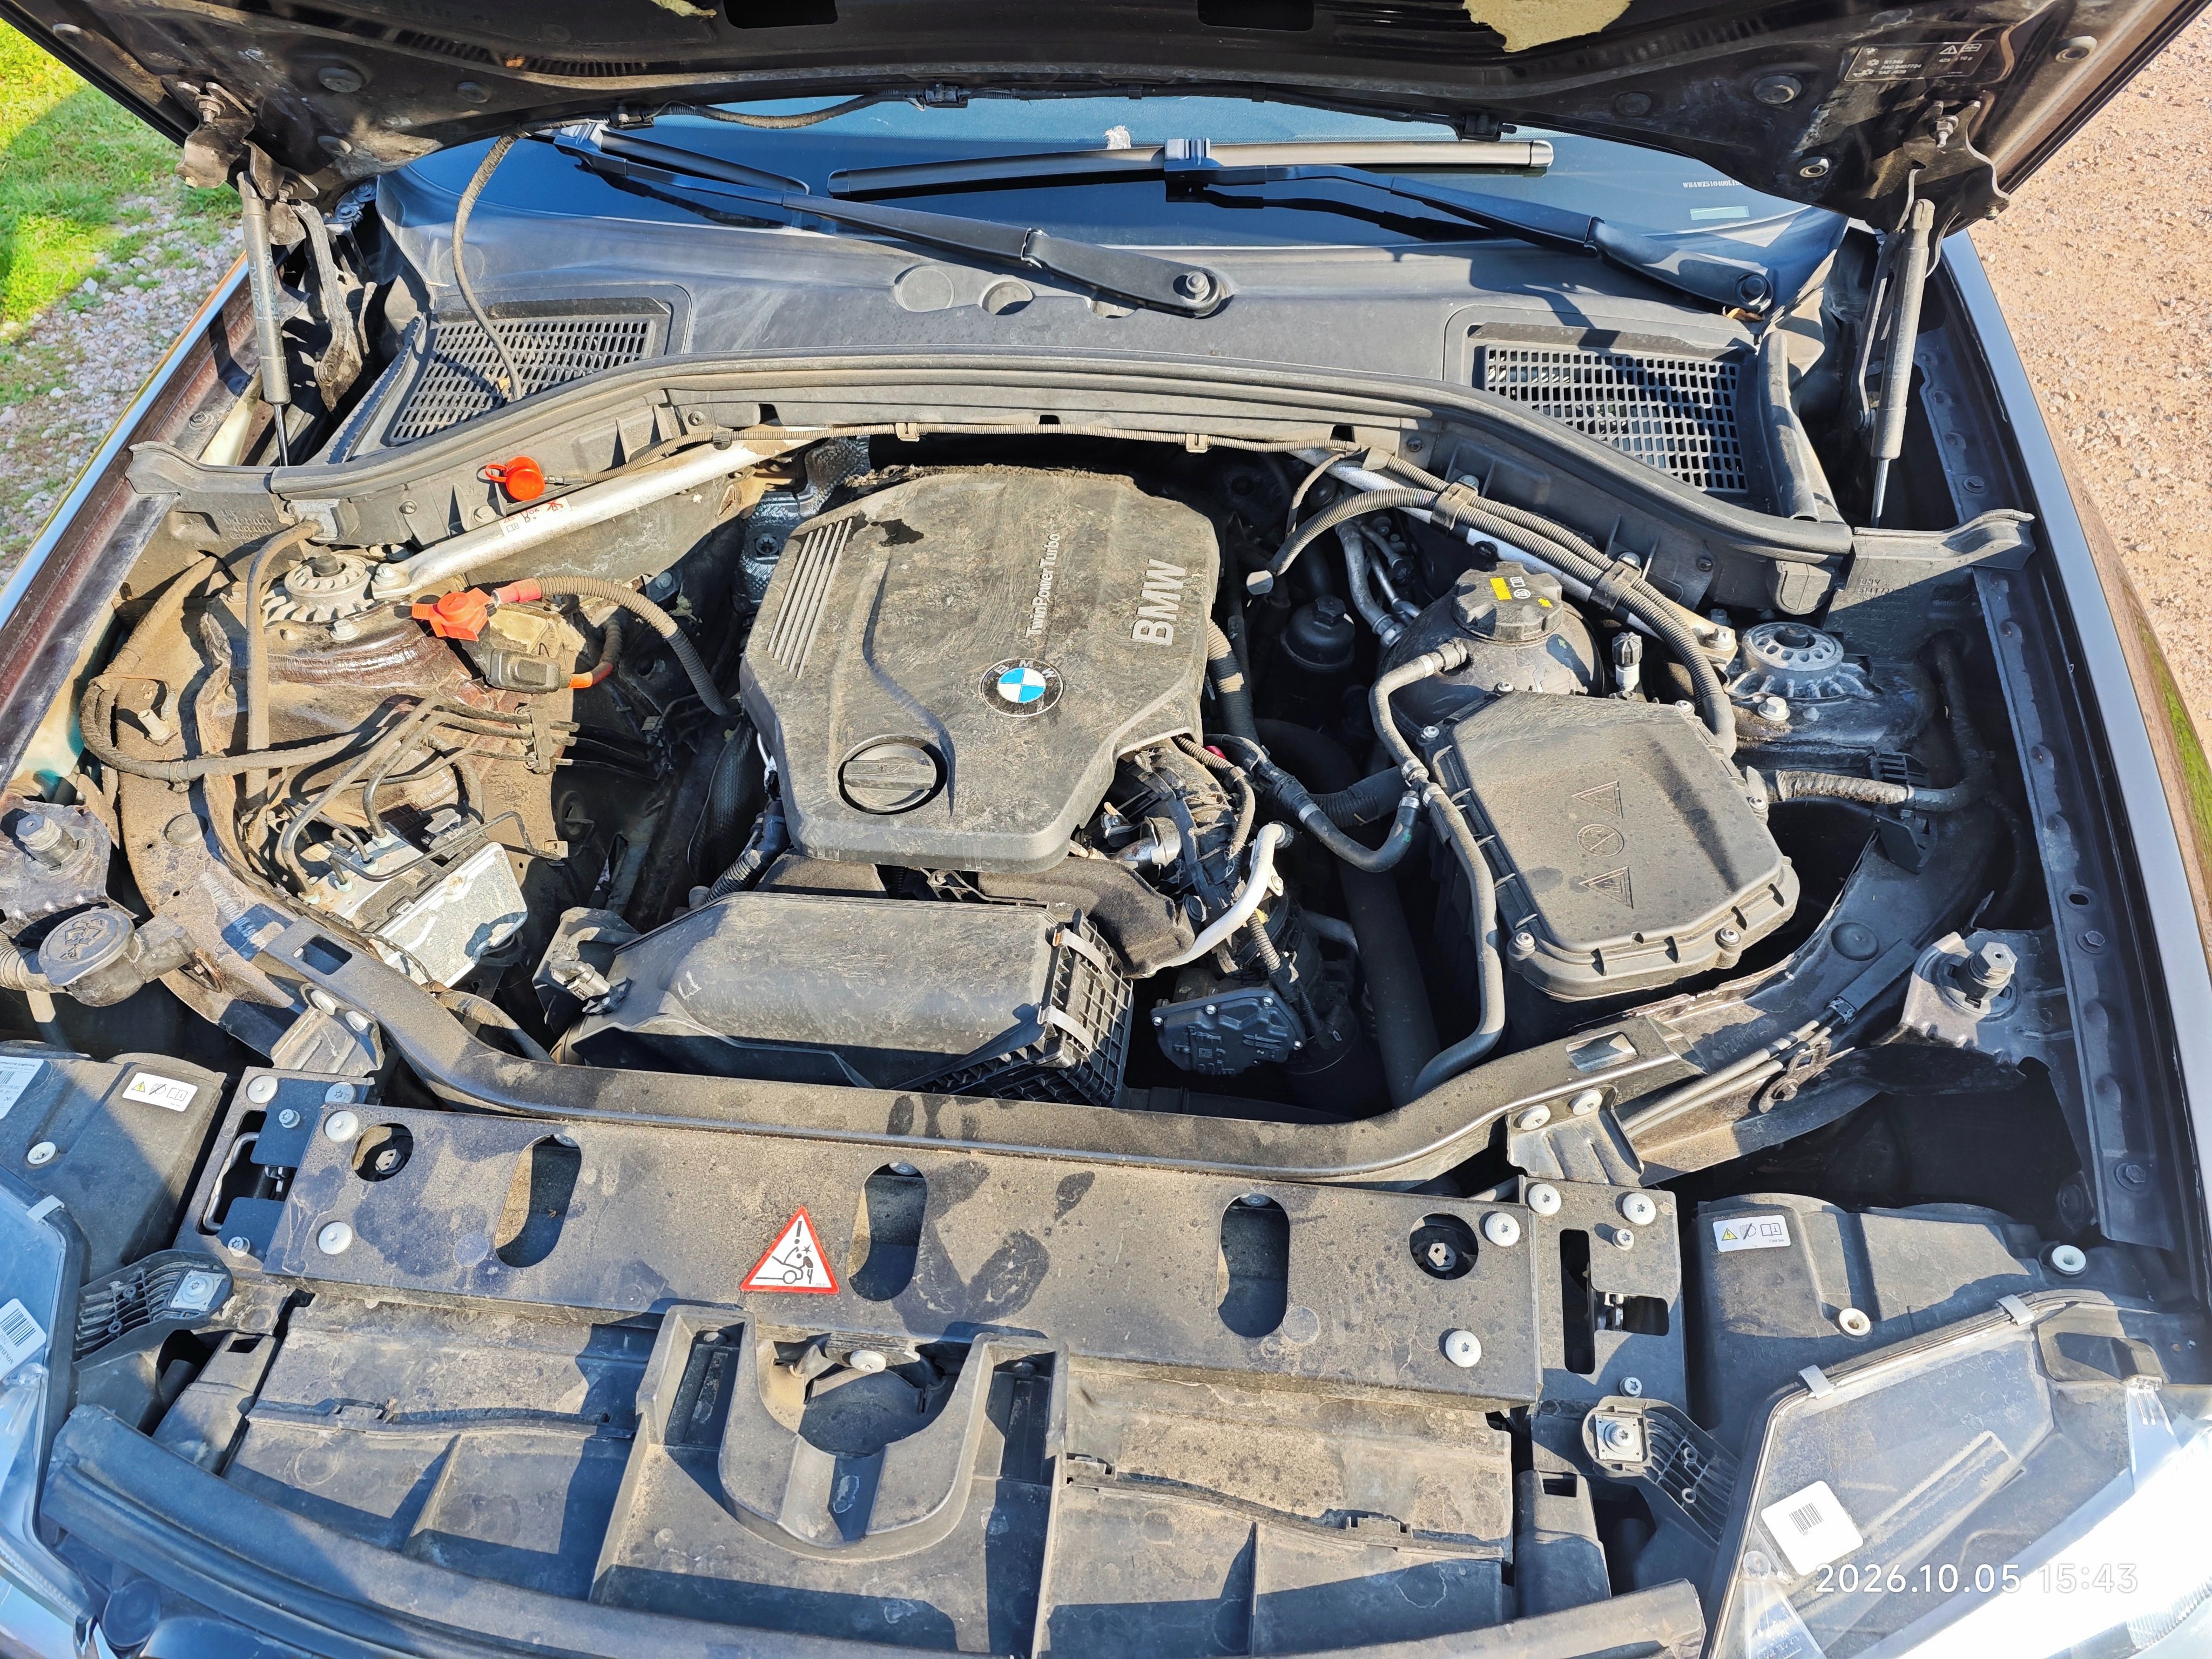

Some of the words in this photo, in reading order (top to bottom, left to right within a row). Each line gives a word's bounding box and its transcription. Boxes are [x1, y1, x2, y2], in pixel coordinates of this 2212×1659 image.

[1026, 532, 1061, 638] TwinPowerTurbo
[1131, 558, 1187, 646] BMW
[994, 659, 1057, 679] BMW
